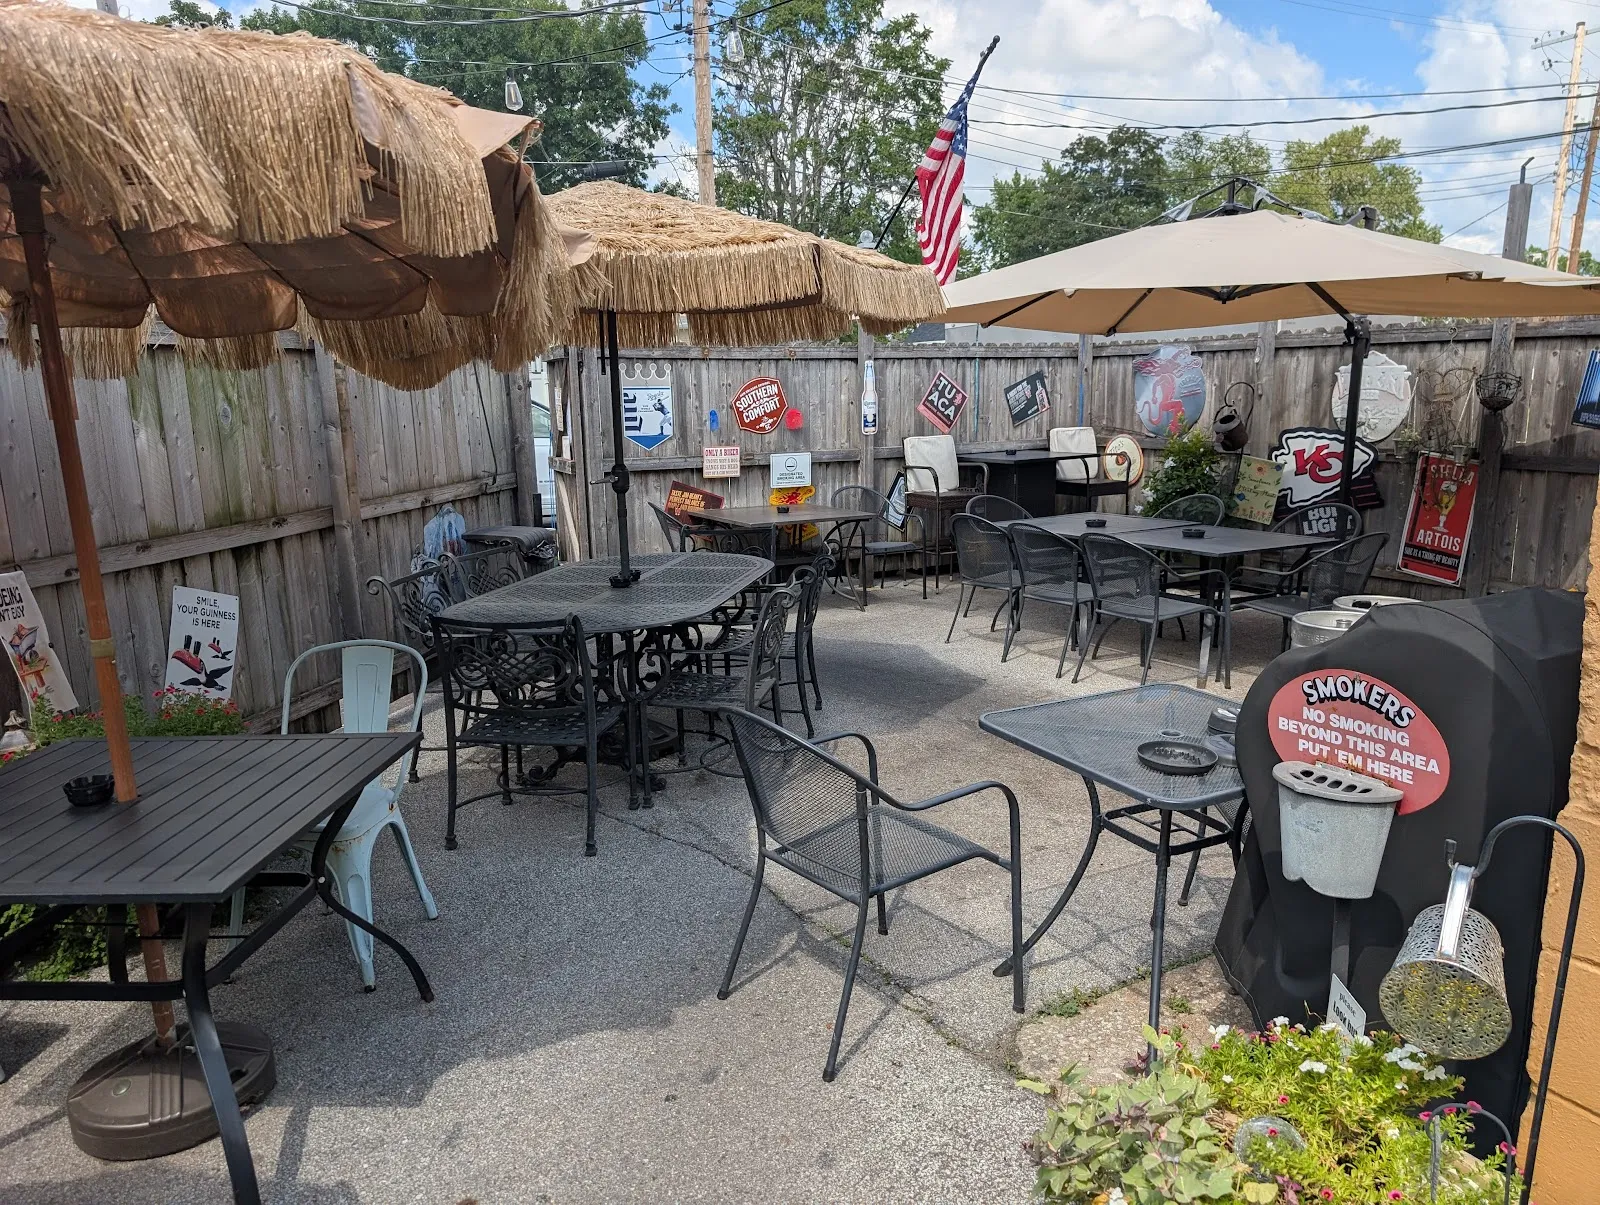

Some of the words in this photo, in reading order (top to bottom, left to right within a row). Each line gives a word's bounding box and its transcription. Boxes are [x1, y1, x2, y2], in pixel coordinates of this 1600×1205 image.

[736, 384, 778, 411] SOUTHERN
[743, 397, 780, 423] COMFORT
[1416, 529, 1461, 552] ARTOIS
[177, 603, 199, 616] YOUR
[200, 607, 236, 621] GUINNESS
[192, 617, 200, 627] IS
[201, 618, 221, 629] HERE
[1302, 674, 1416, 728] SMOKERS
[1302, 706, 1326, 724] NO
[1329, 713, 1411, 748] SMOKING
[1278, 716, 1343, 746] BEYOND
[1346, 734, 1386, 759] THIS
[1389, 749, 1441, 775] AREA
[1298, 738, 1331, 759] PUT
[1366, 758, 1414, 785] HERE
